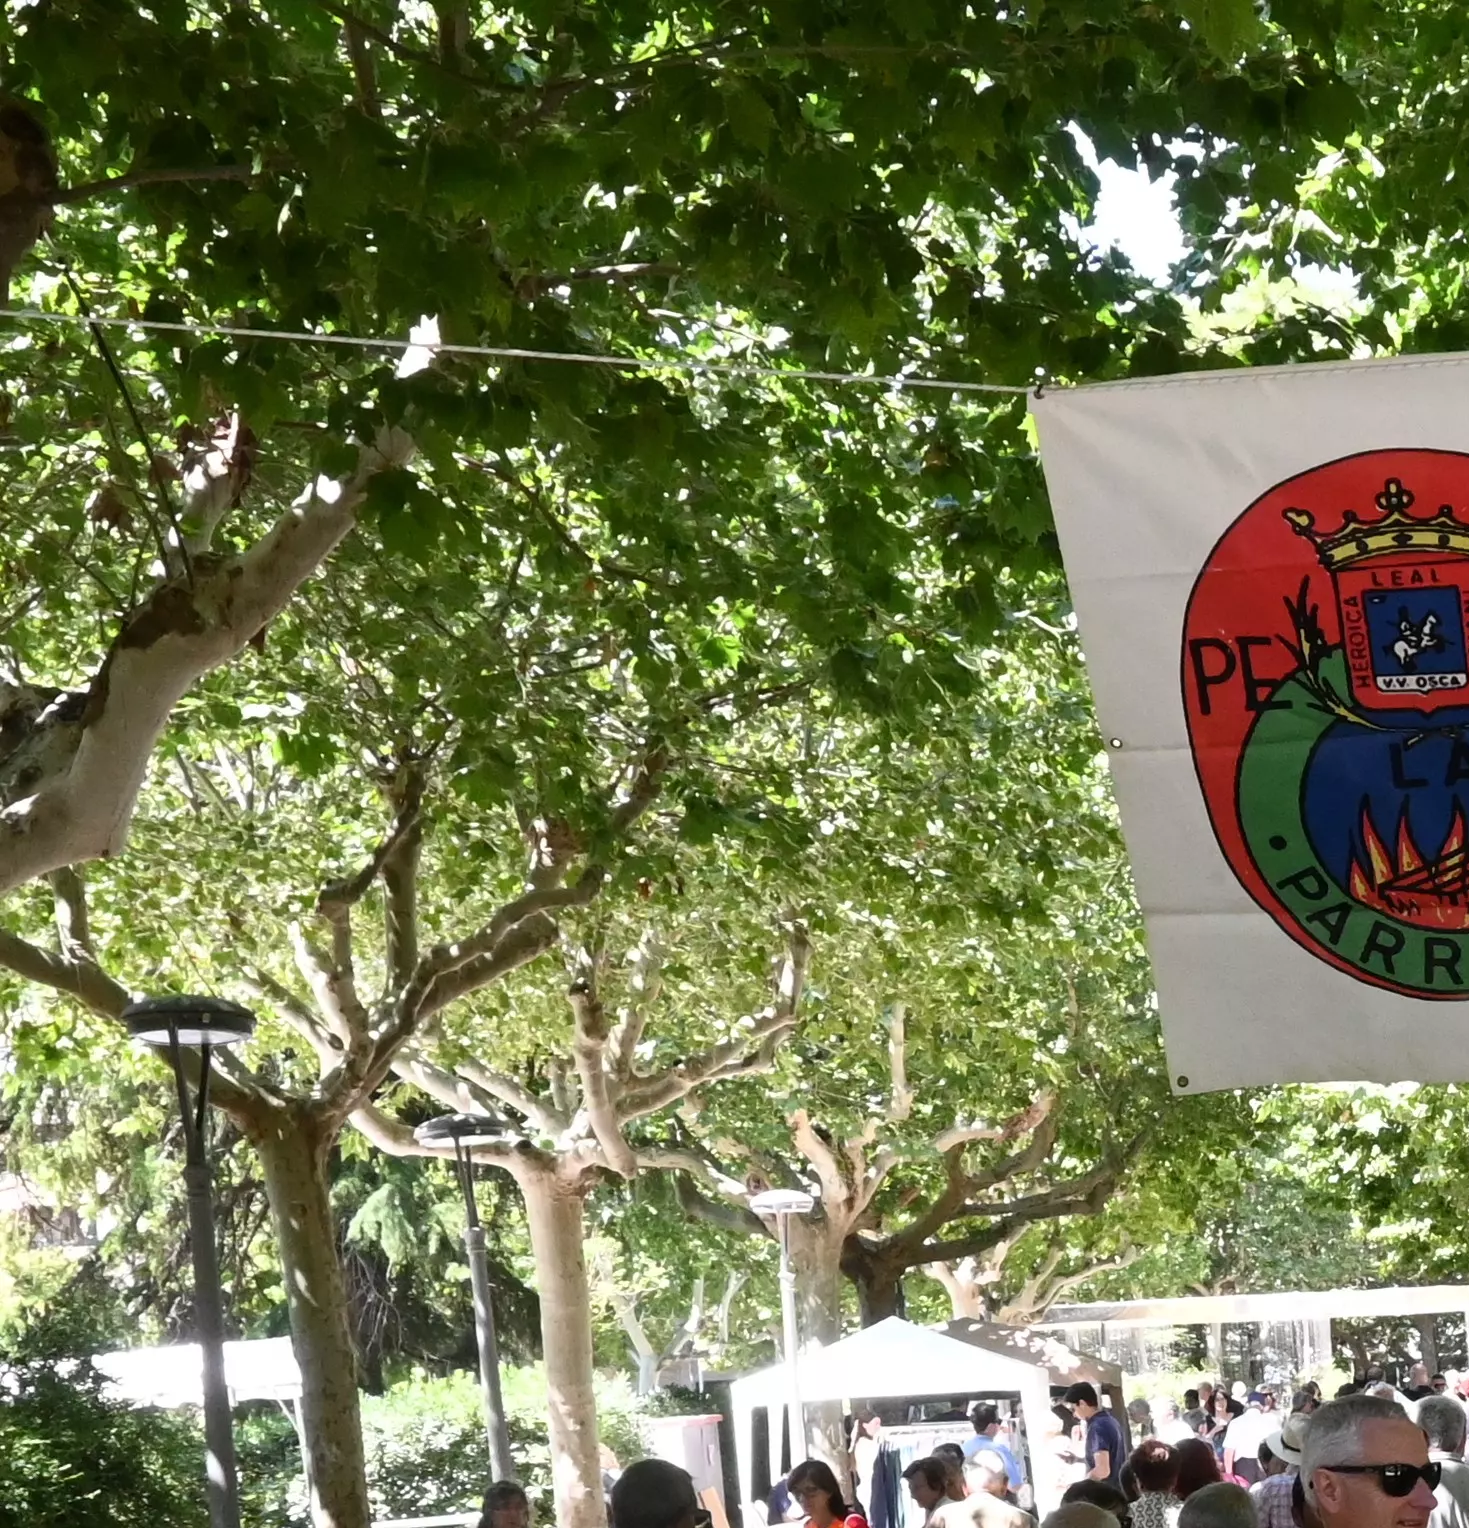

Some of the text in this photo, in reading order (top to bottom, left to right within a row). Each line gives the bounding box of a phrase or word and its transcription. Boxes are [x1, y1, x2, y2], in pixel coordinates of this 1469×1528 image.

[1370, 567, 1441, 587] LEAL
[1343, 595, 1372, 689] HEROICA
[1415, 675, 1461, 688] OSCA
